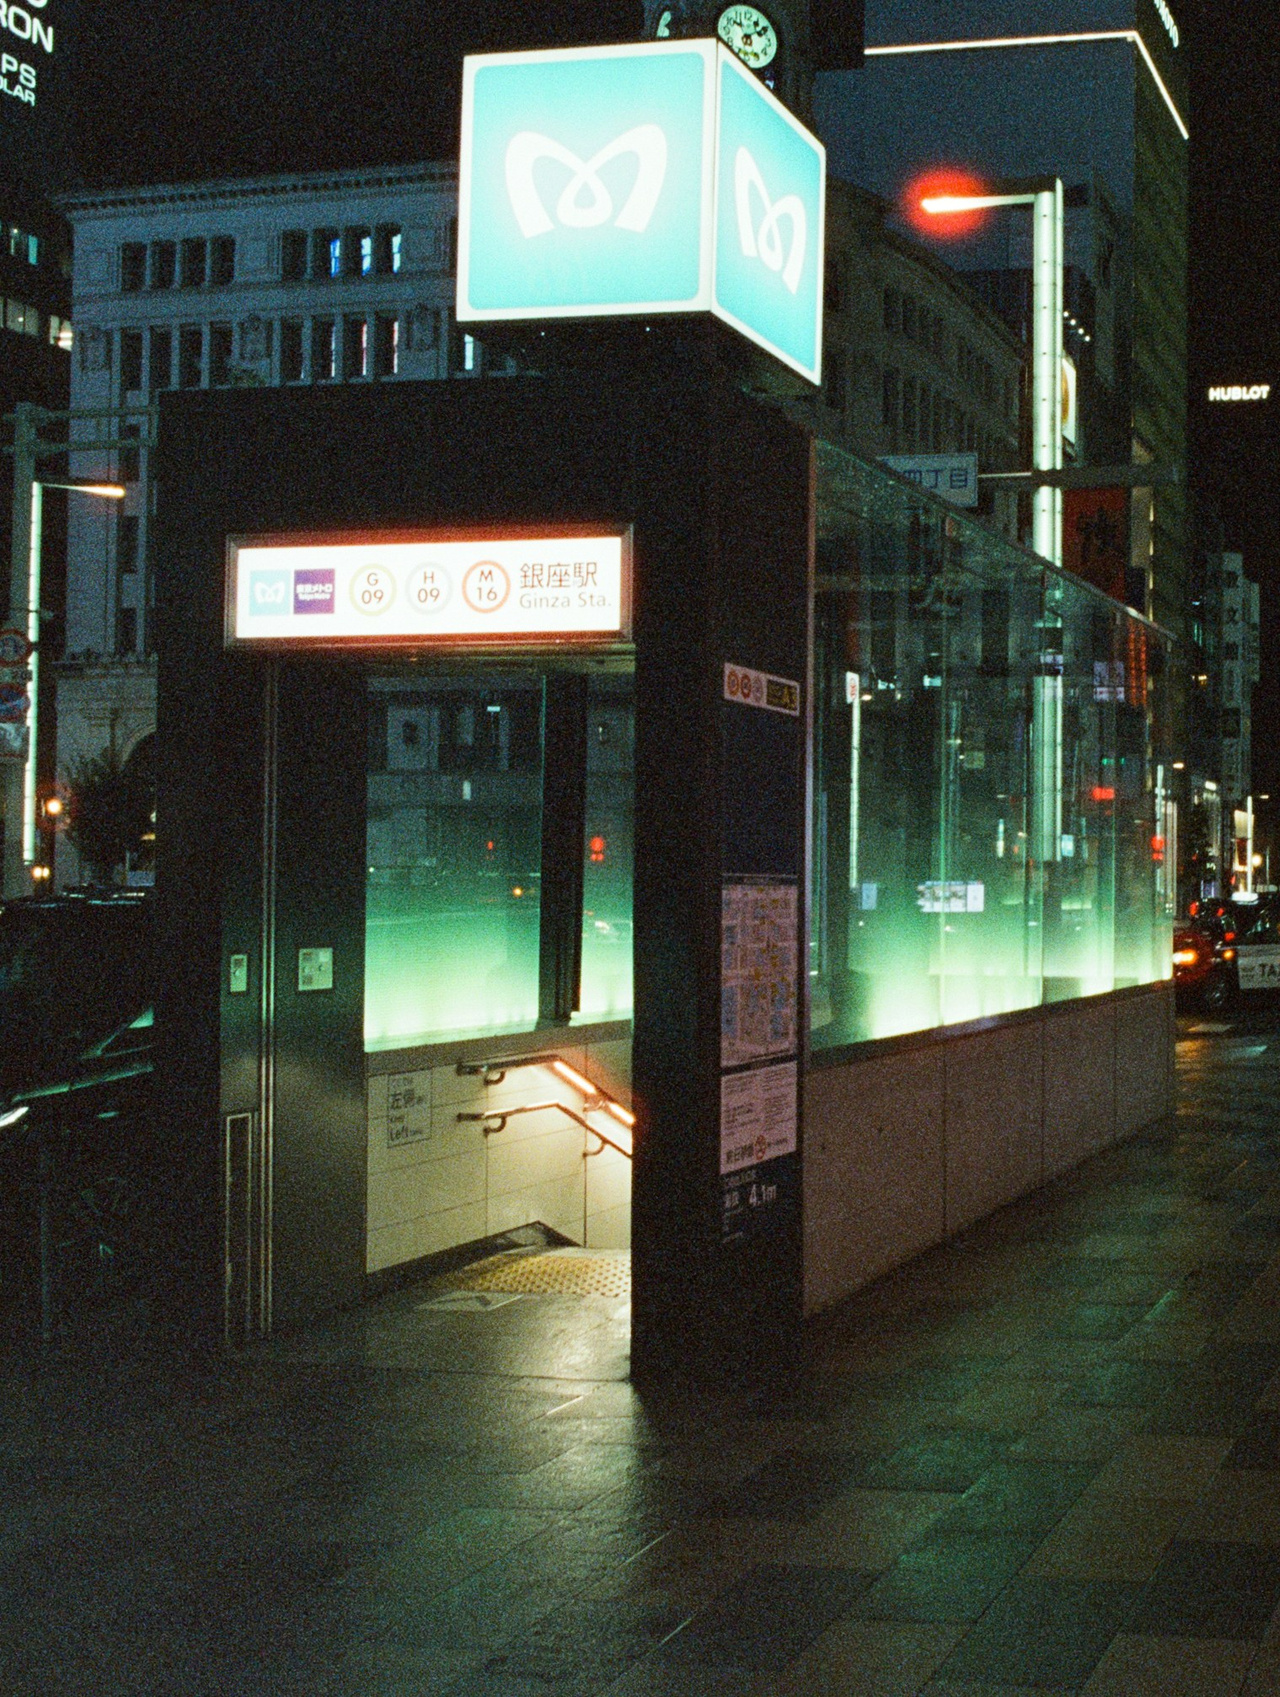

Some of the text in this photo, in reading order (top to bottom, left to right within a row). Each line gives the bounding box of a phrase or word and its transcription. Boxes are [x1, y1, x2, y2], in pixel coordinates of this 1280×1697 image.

[1208, 384, 1270, 401] HUBLOT
[367, 572, 379, 586] G
[424, 571, 434, 584] H
[479, 569, 494, 583] M
[520, 562, 598, 589] 銀座駅
[361, 589, 384, 604] 09
[417, 588, 440, 603] 09
[477, 587, 498, 601] 16
[519, 592, 612, 609] Ginza Sta.
